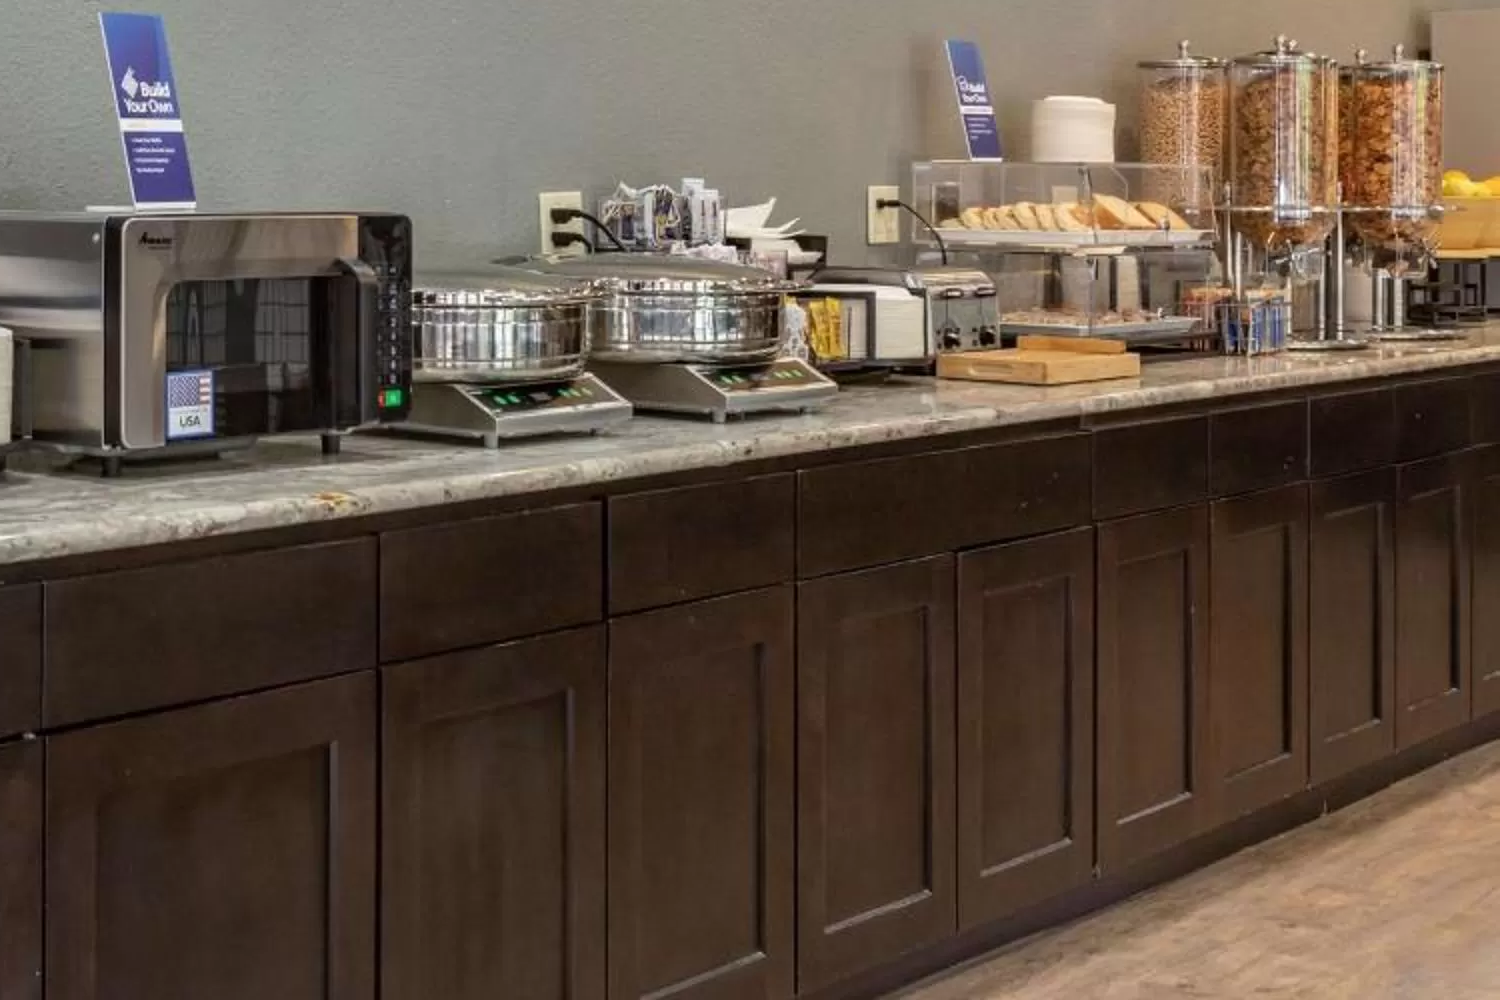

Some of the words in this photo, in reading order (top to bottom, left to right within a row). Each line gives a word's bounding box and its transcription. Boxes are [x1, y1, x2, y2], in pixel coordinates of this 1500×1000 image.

[140, 81, 171, 97] Build
[123, 98, 147, 113] Your
[148, 99, 175, 113] Own
[179, 415, 201, 427] USA
